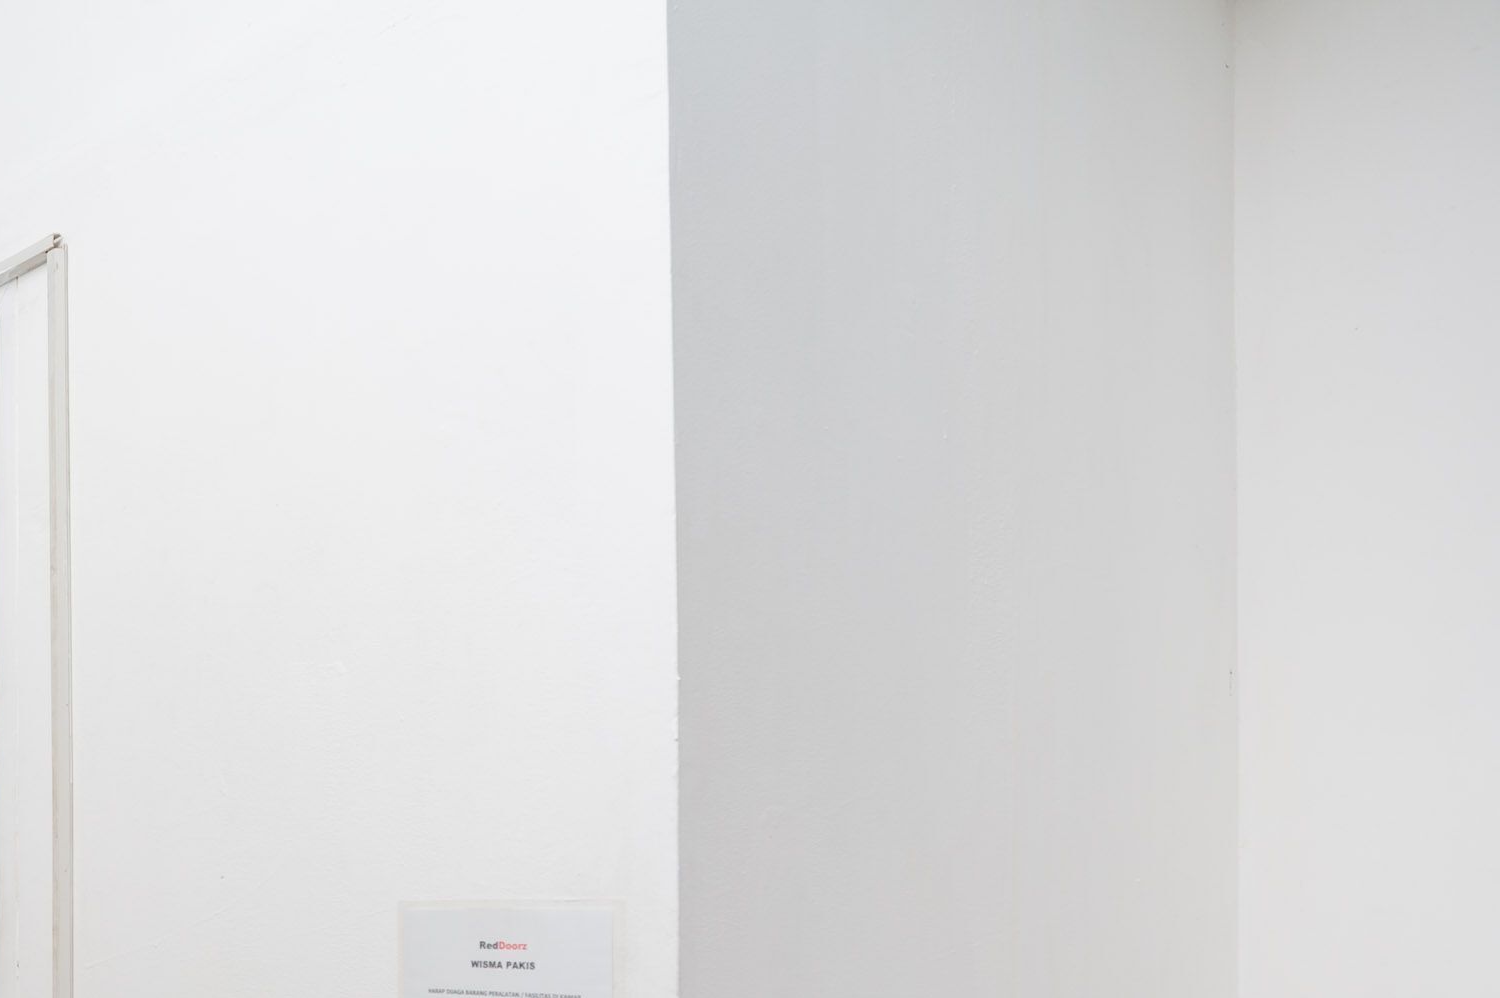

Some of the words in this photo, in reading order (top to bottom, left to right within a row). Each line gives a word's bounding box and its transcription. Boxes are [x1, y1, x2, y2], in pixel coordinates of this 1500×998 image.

[479, 941, 527, 951] RedDoorz
[470, 960, 503, 970] WISMA
[506, 961, 536, 971] PAKIS
